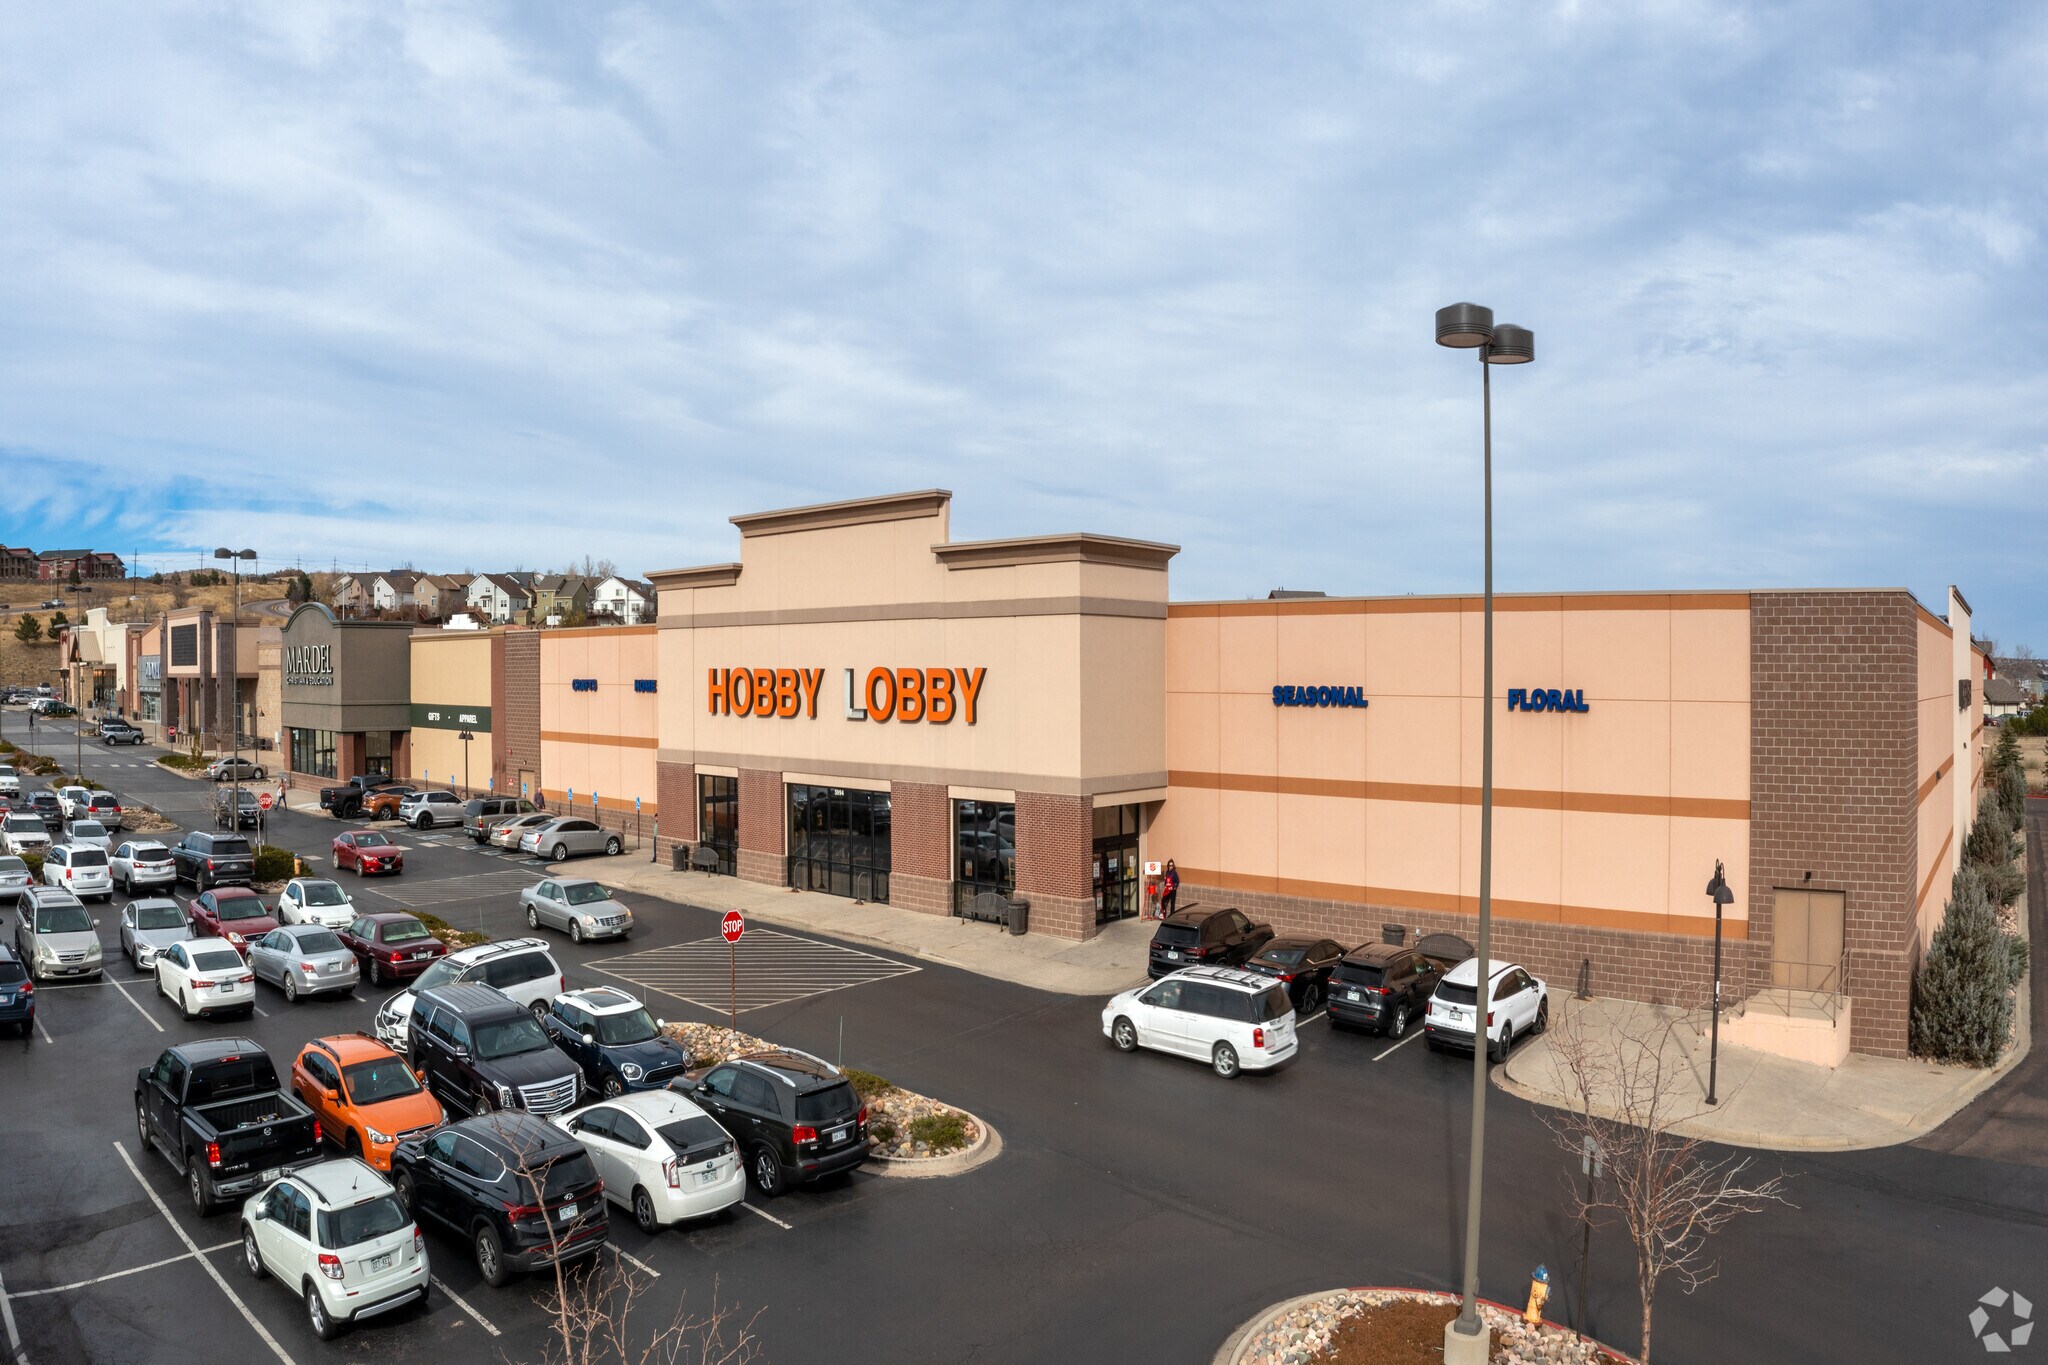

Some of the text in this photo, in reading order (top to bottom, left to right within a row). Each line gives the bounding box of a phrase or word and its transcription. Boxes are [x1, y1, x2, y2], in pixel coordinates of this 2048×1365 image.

[286, 645, 333, 674] MARDEL
[572, 678, 598, 692] CRAFTS
[634, 679, 658, 693] HOME
[708, 666, 988, 725] HOBBY LOBBY
[1272, 686, 1368, 708] SEASONAL
[1508, 688, 1589, 712] FLORAL
[427, 712, 478, 724] GIFTS APPAREL
[260, 797, 272, 805] STOP
[724, 920, 742, 933] STOP
